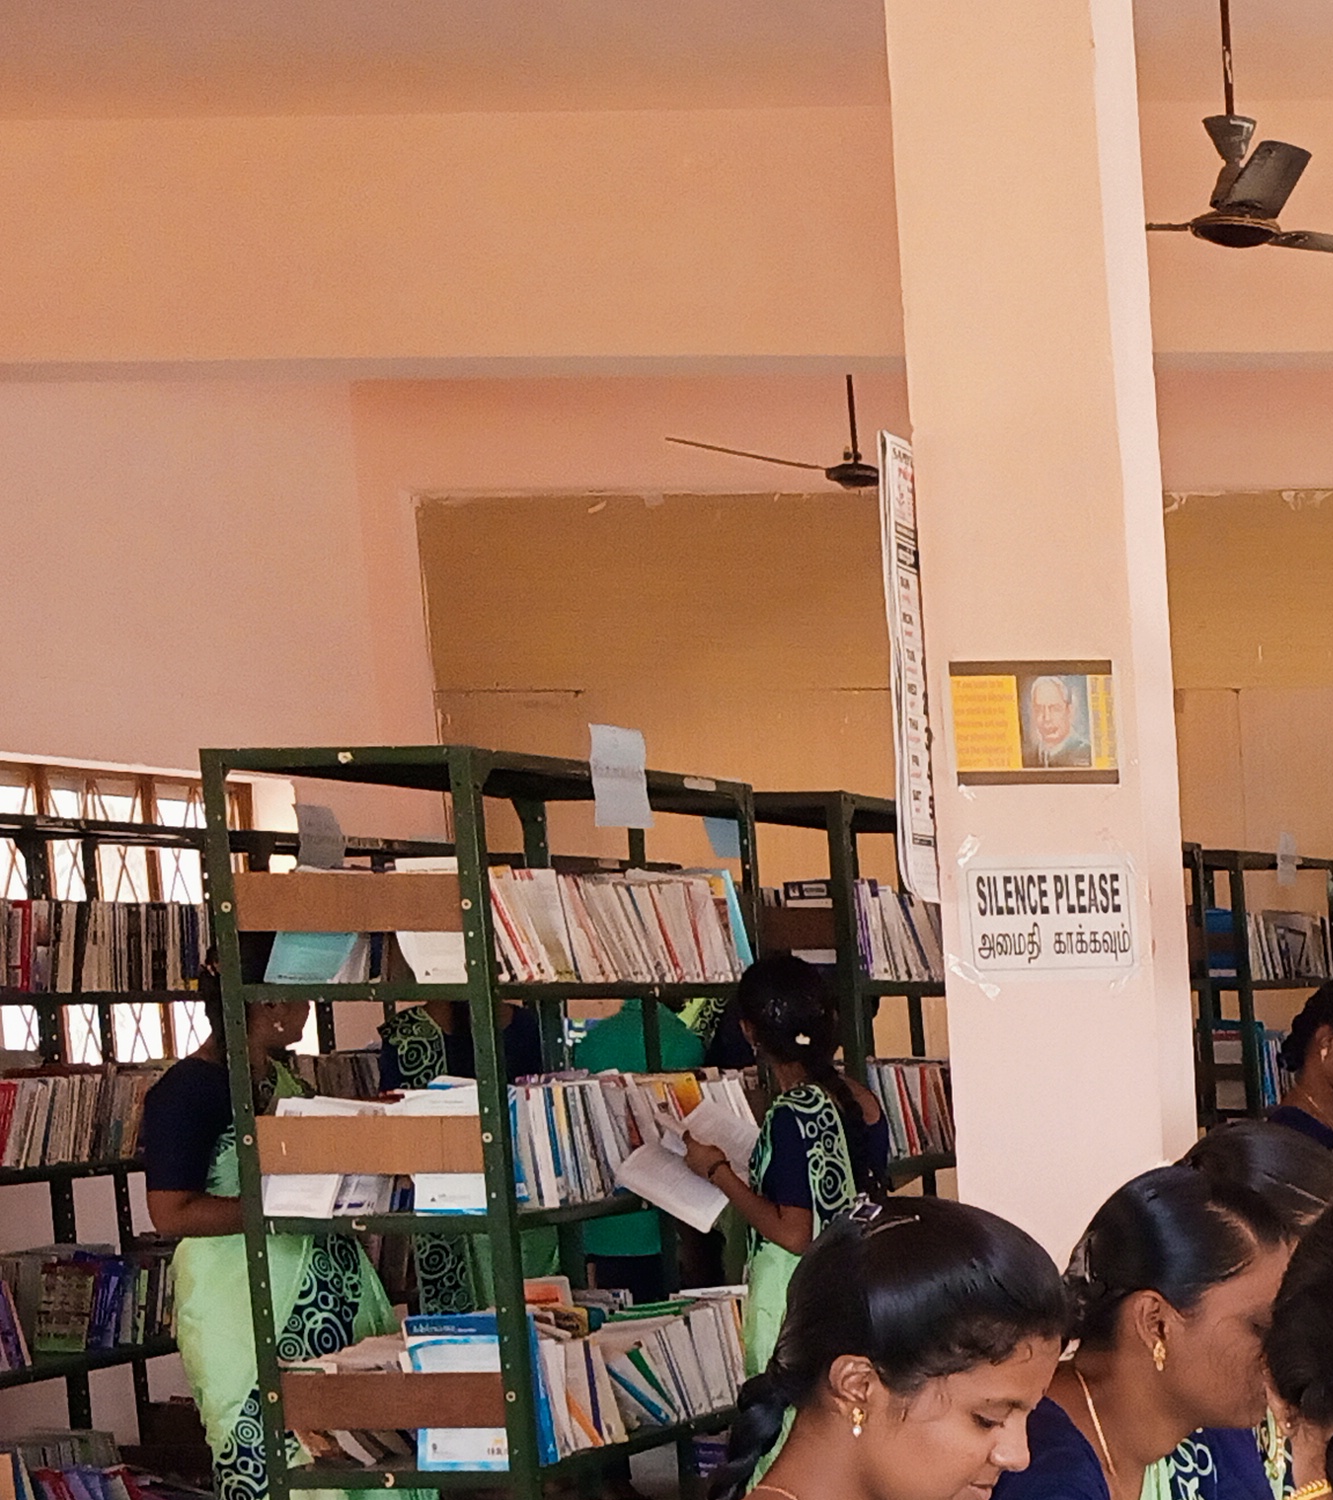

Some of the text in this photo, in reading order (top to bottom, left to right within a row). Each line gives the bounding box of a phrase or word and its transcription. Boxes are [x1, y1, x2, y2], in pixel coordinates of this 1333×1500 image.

[976, 873, 1121, 916] SILENCE PLEASE
[978, 922, 1131, 964] அமைதி காக்கவும்
